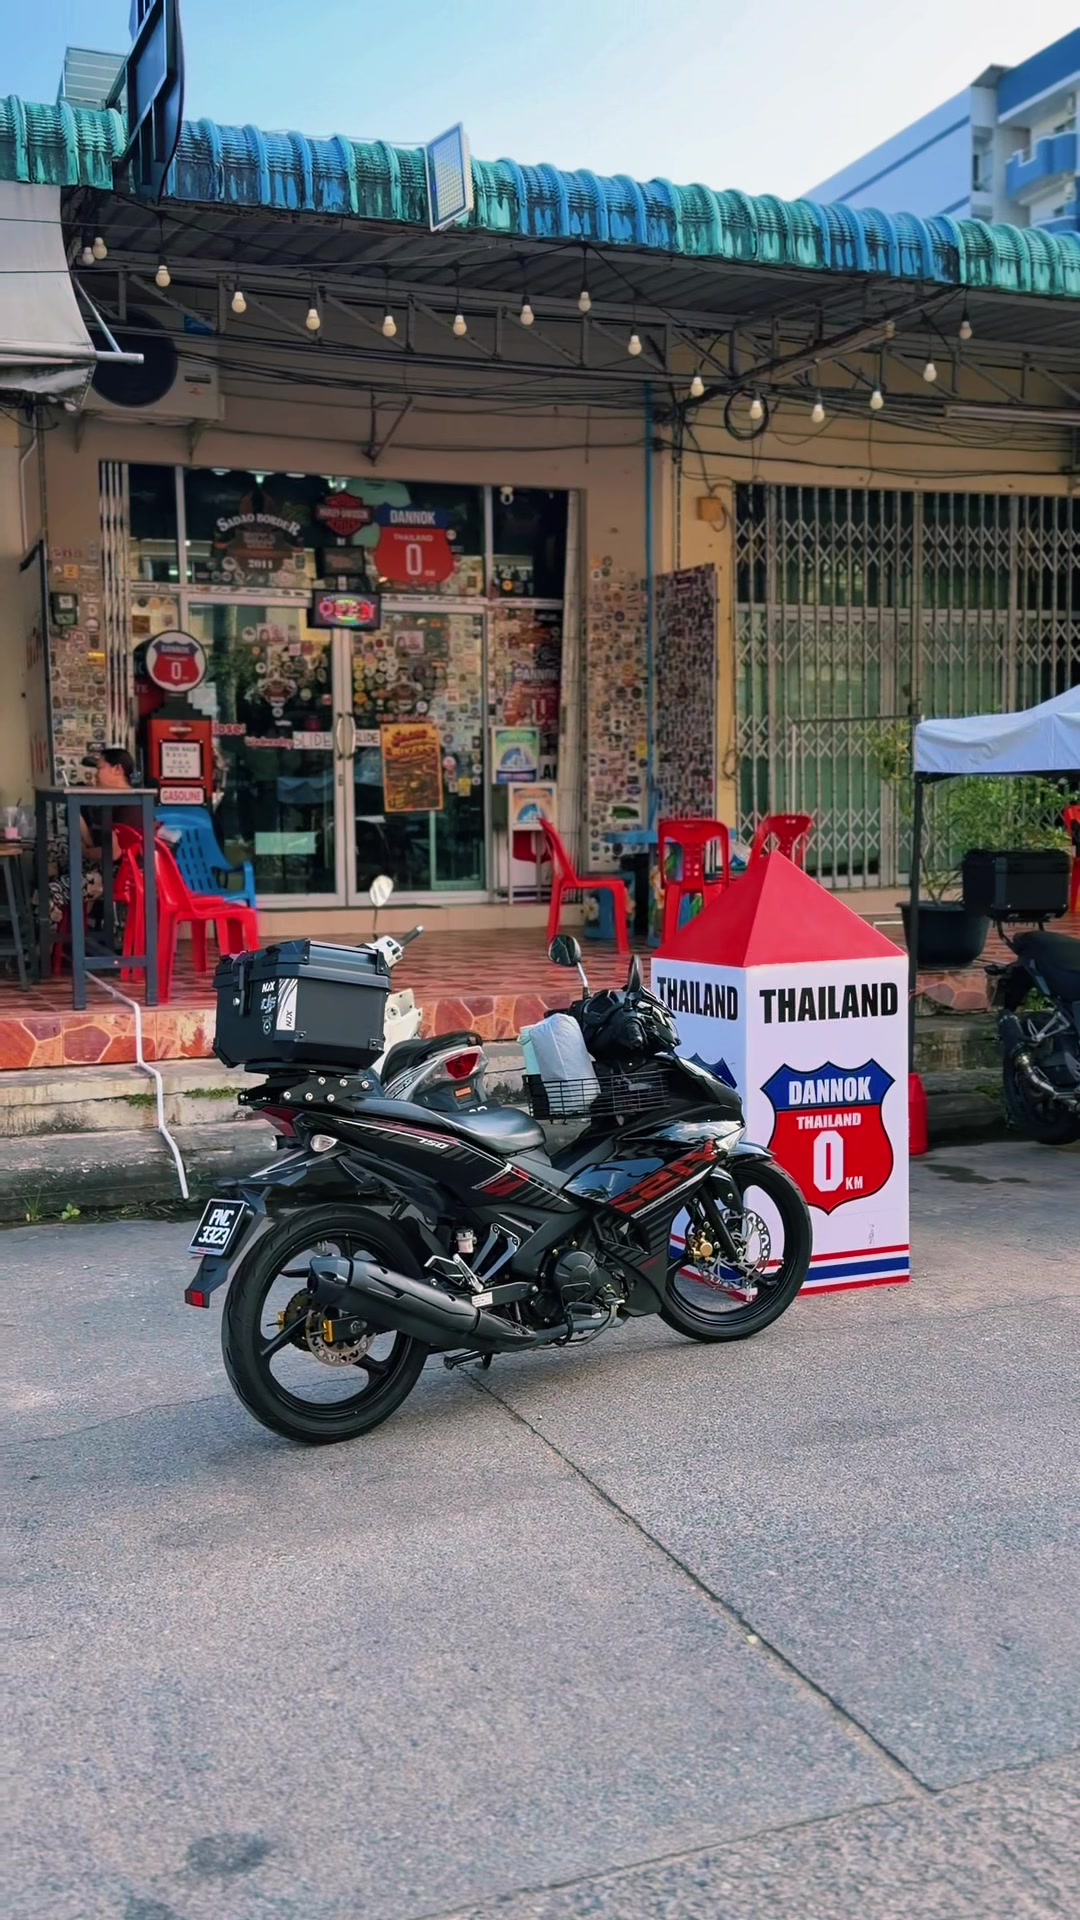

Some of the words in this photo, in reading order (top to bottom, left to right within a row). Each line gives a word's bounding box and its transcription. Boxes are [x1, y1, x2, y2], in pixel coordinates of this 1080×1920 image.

[216, 513, 255, 532] SADAO
[256, 513, 301, 536] BORDER
[390, 509, 436, 525] DANNOK
[393, 533, 434, 543] THAILAND
[248, 559, 273, 569] 2011
[406, 544, 422, 576] 0
[319, 600, 375, 620] OPEN
[171, 661, 182, 680] 0
[295, 733, 333, 748] SLIDE
[163, 790, 202, 801] GASOLINE
[657, 976, 738, 1021] THAILAND
[759, 982, 898, 1024] THAILAND
[788, 1076, 872, 1106] DANNOK
[796, 1112, 862, 1130] THAILAND
[813, 1130, 844, 1193] 0
[845, 1175, 864, 1190] KM
[209, 1208, 235, 1226] PNC
[198, 1226, 230, 1245] 3323
